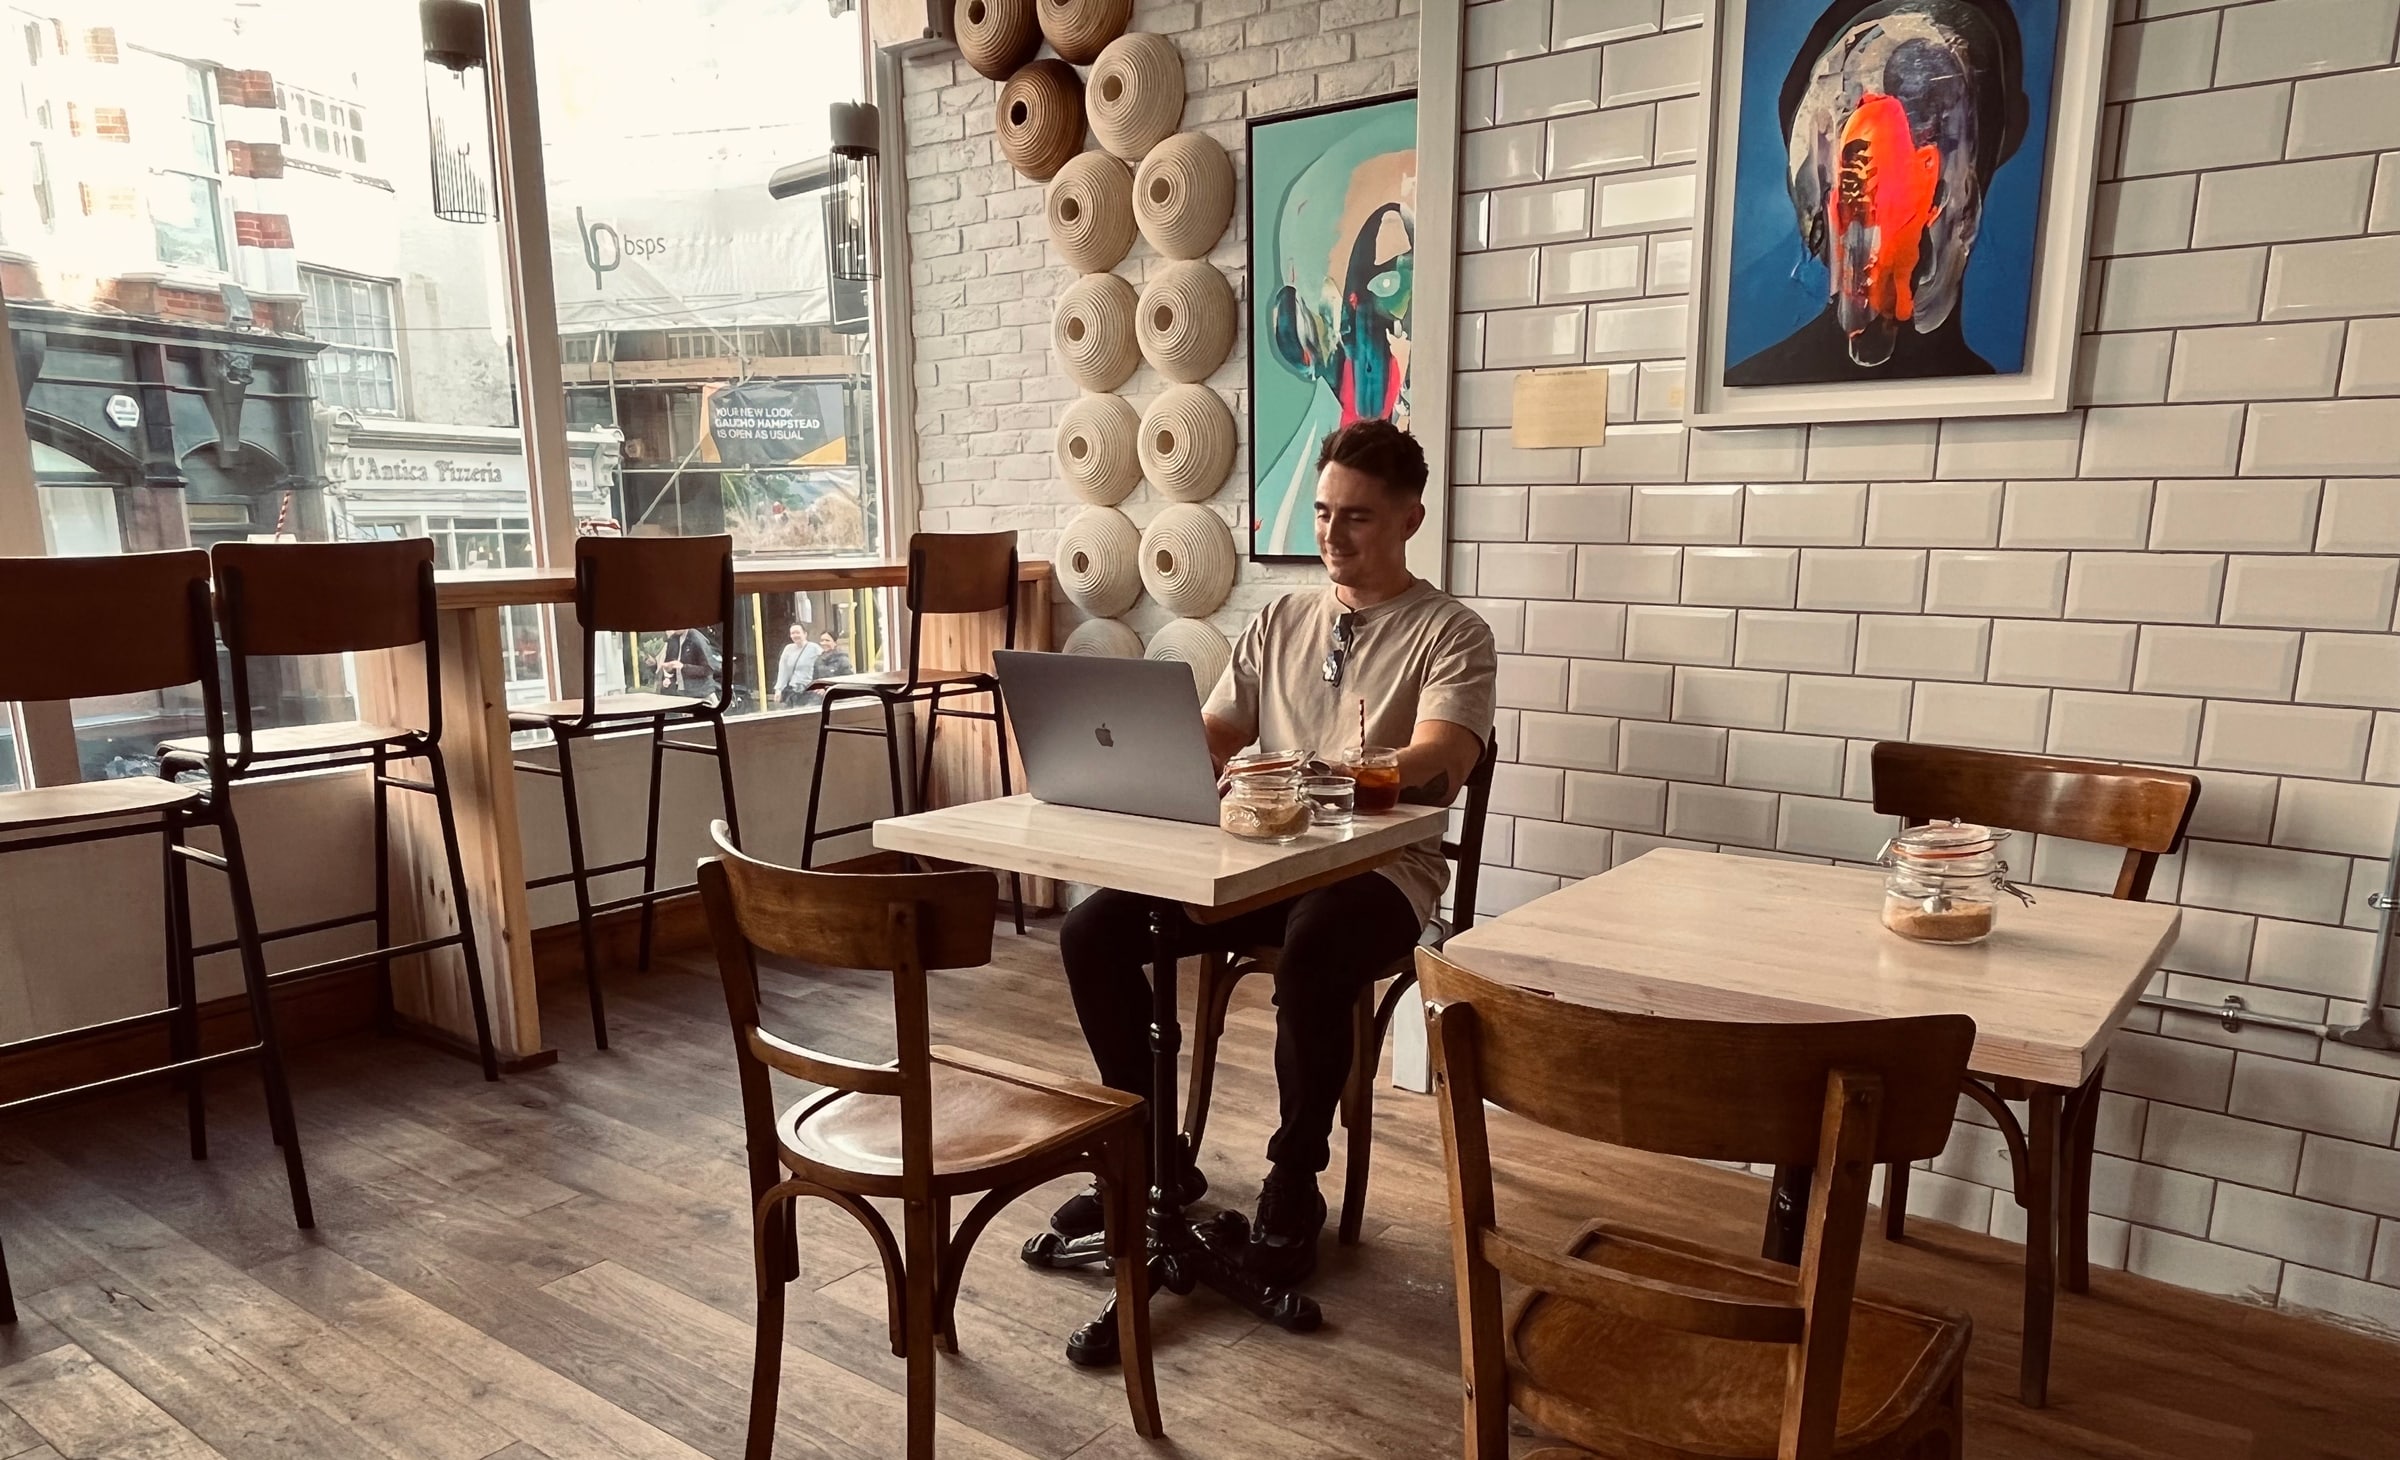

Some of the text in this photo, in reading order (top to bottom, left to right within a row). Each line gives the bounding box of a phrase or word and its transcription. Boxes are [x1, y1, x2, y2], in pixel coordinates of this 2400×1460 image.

[623, 233, 666, 261] bsps
[740, 407, 763, 418] NEW
[765, 408, 793, 418] LOOK
[757, 418, 820, 429] HAMPSTEAD
[716, 429, 728, 439] IS
[754, 429, 769, 440] AS
[769, 429, 804, 441] USUAL
[347, 456, 502, 483] L'Antica Pizzeria
